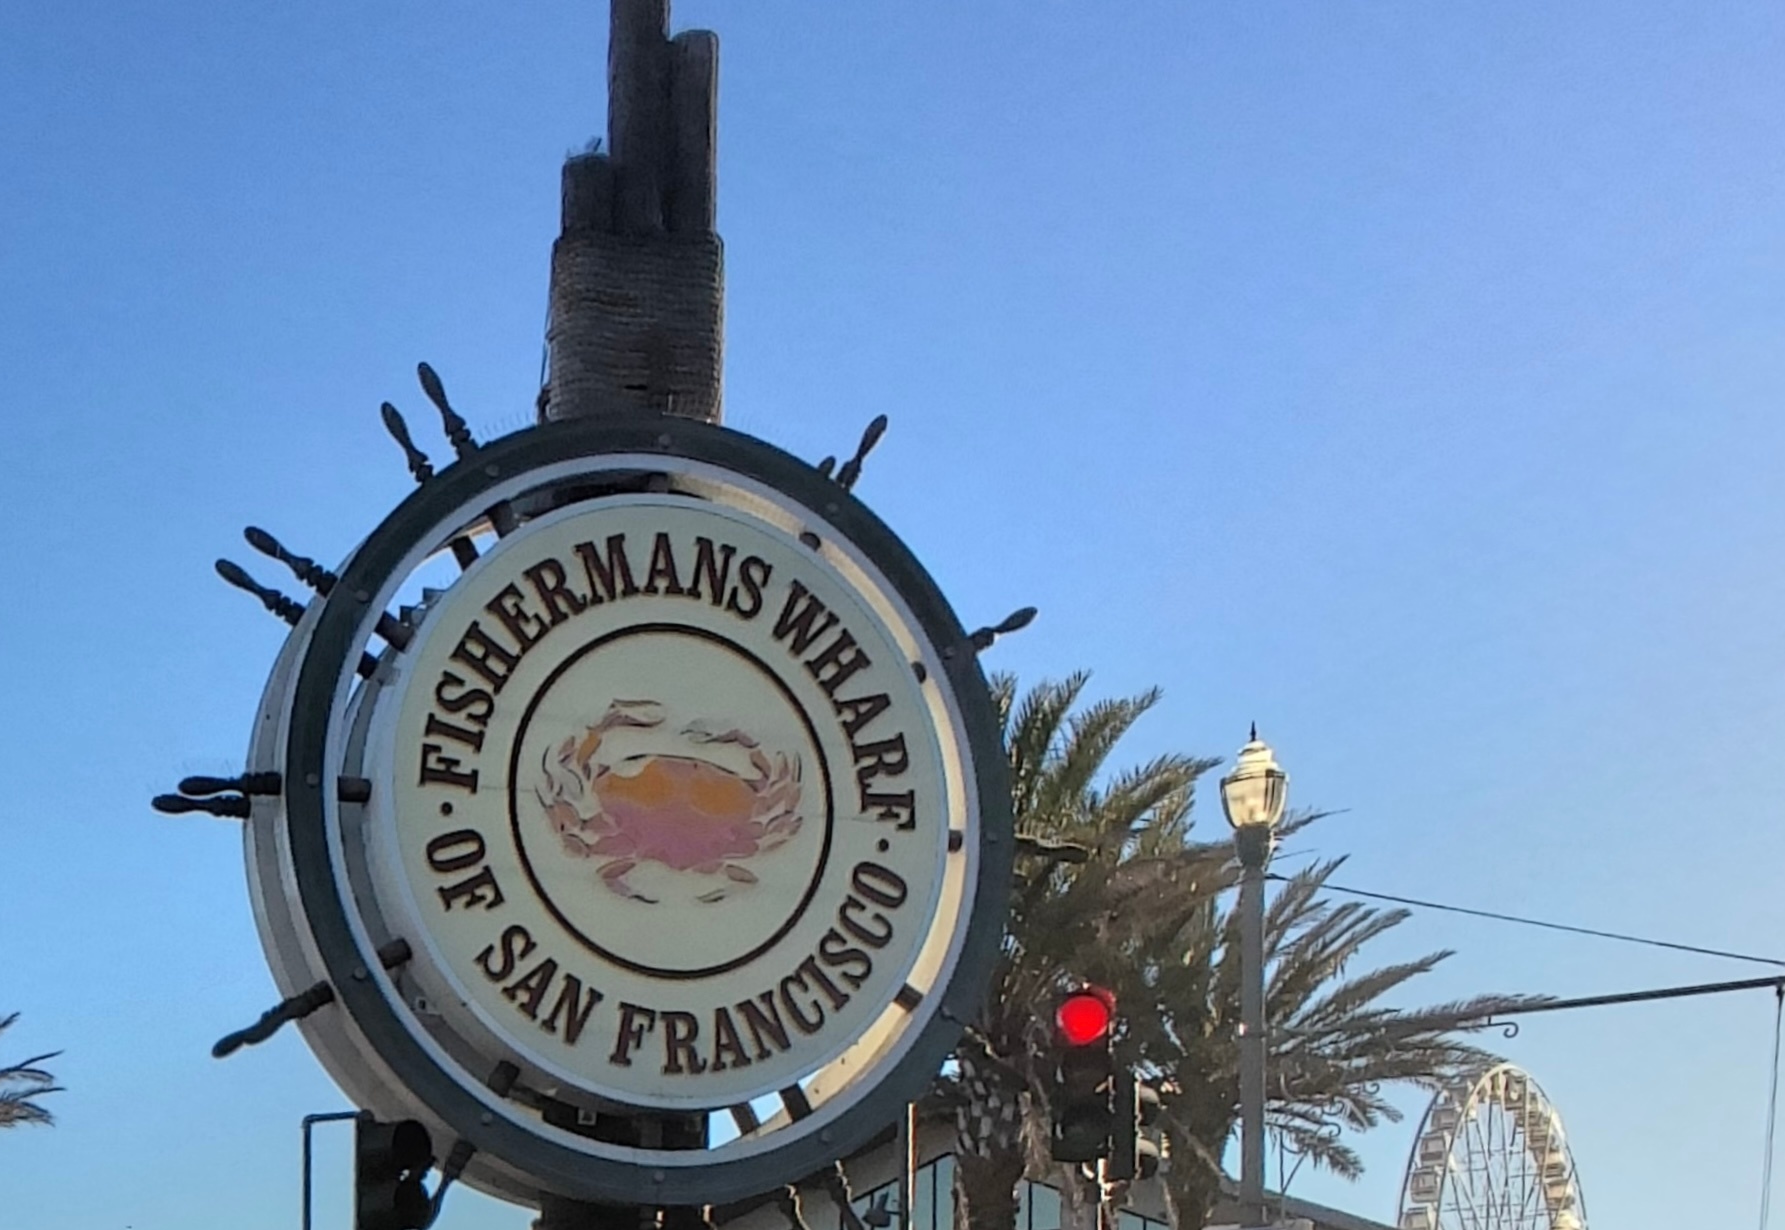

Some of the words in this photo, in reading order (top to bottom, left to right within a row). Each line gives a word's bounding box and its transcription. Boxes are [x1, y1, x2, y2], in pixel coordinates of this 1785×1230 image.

[418, 530, 774, 796] FISHERMANS
[772, 578, 918, 833] WHARF
[425, 827, 507, 912] OF
[475, 924, 604, 1046] SAN
[610, 859, 909, 1078] FRANCISCO
